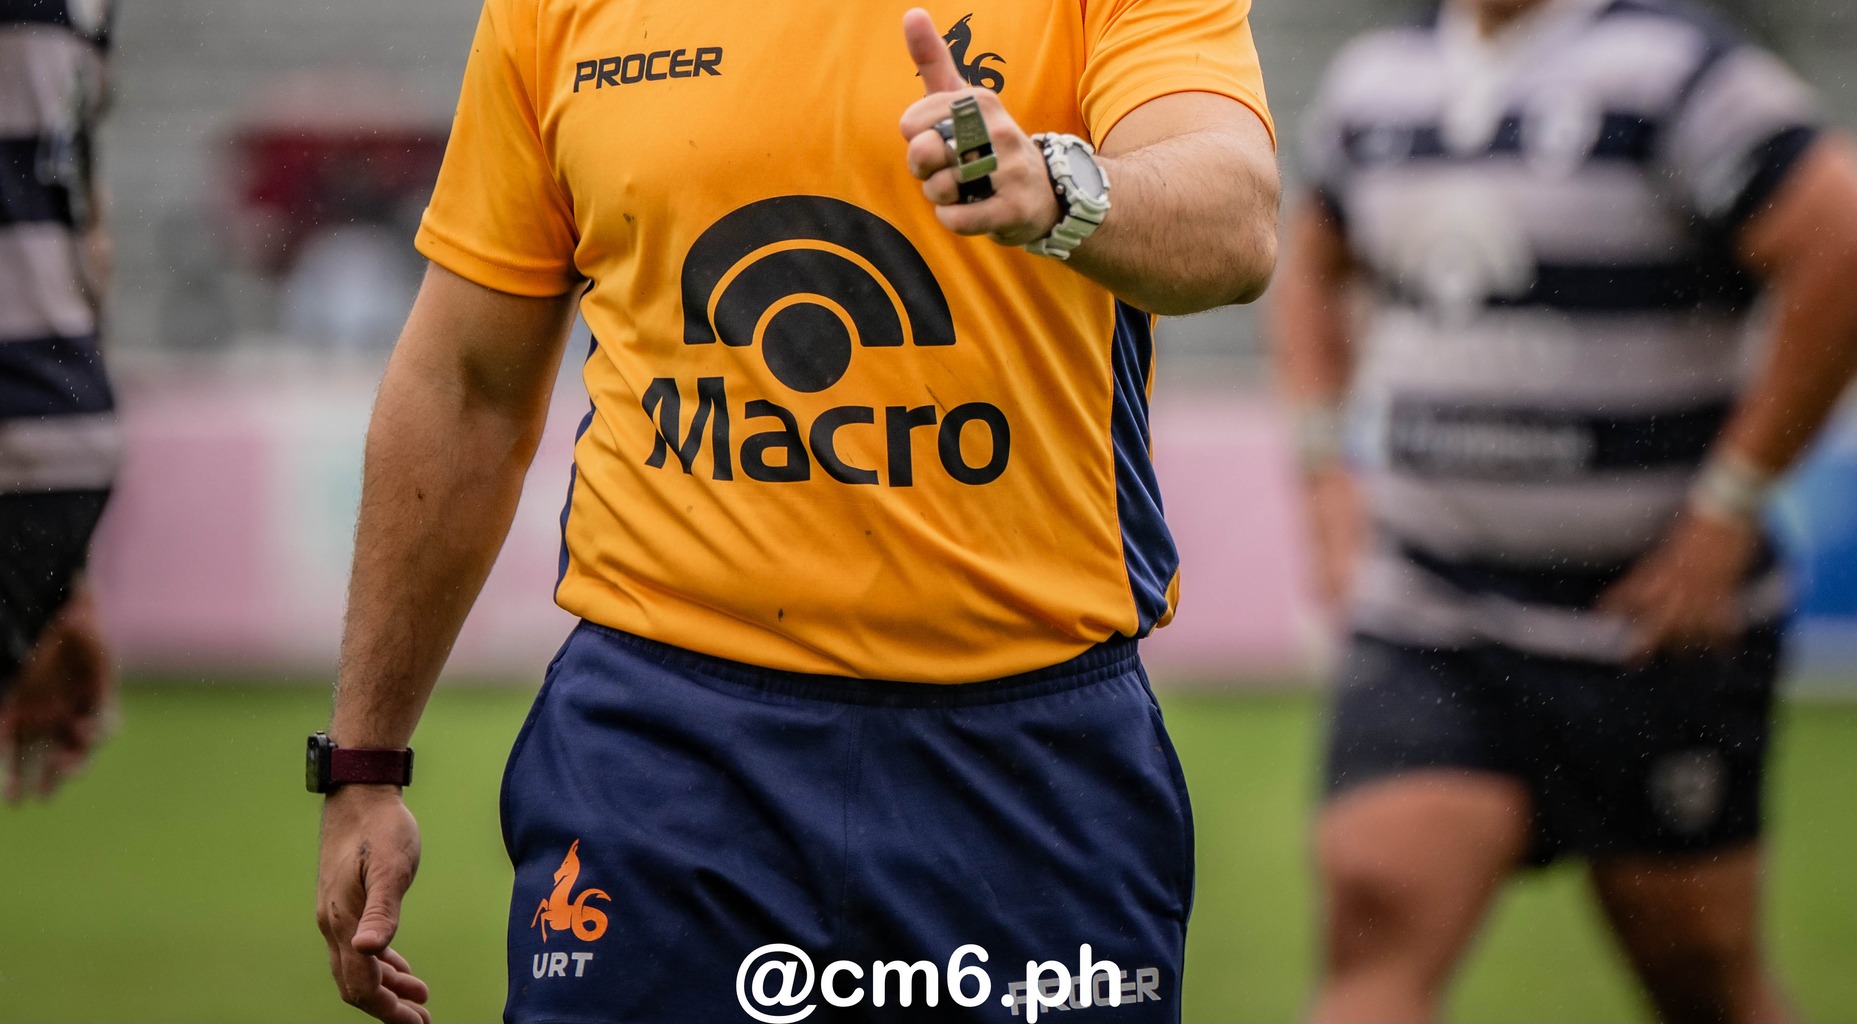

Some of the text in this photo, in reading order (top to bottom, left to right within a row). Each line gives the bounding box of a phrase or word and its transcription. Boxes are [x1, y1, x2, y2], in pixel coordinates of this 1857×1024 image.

[573, 46, 723, 93] PROCER
[641, 376, 1011, 488] Macro
[532, 951, 594, 979] URT
